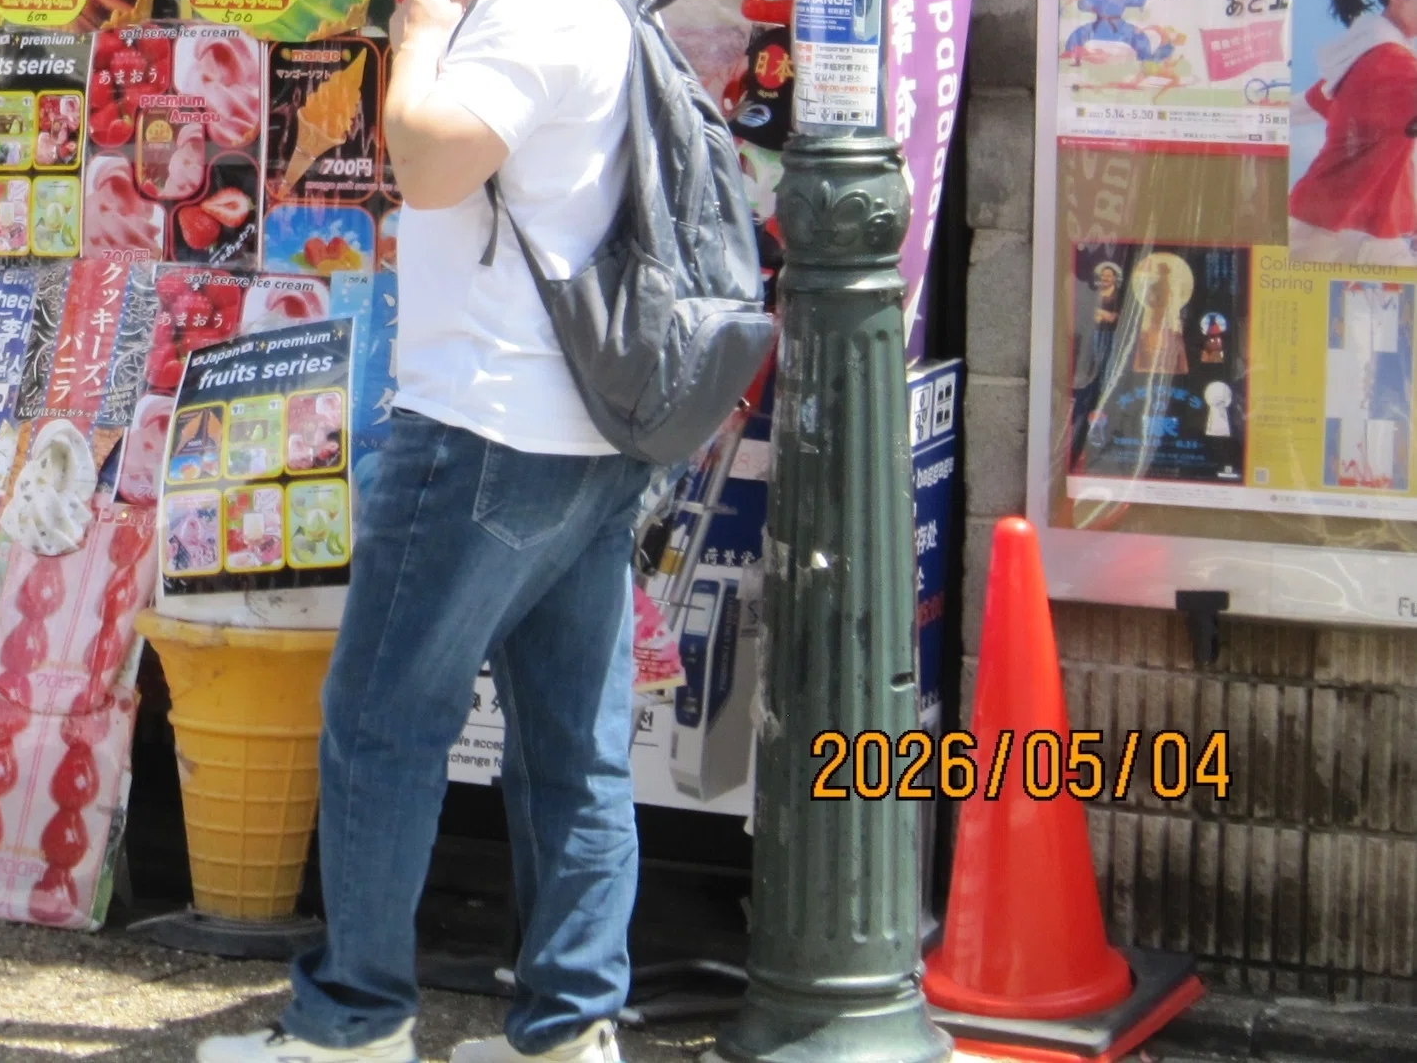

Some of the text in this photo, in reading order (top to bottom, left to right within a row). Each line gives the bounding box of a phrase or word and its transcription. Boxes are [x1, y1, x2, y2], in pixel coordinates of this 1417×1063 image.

[26, 12, 48, 23] 600
[220, 9, 254, 24] 500
[19, 33, 75, 48] premium
[120, 27, 240, 39] soft serve ice cream
[290, 48, 342, 63] mango
[16, 55, 76, 76] series
[275, 69, 331, 80] マンゴーソフト
[754, 51, 796, 84] 日本
[139, 94, 207, 109] premium
[169, 110, 222, 125] Amaou
[319, 158, 374, 177] 700円
[101, 249, 151, 264] 700円
[184, 271, 316, 293] soft serve ice cream
[1259, 273, 1314, 295] Spring
[80, 262, 124, 386] クッキーズ
[202, 331, 332, 367] Japan premium
[52, 332, 84, 405] バニラ
[197, 353, 334, 392] fruits series
[915, 456, 955, 489] baggage
